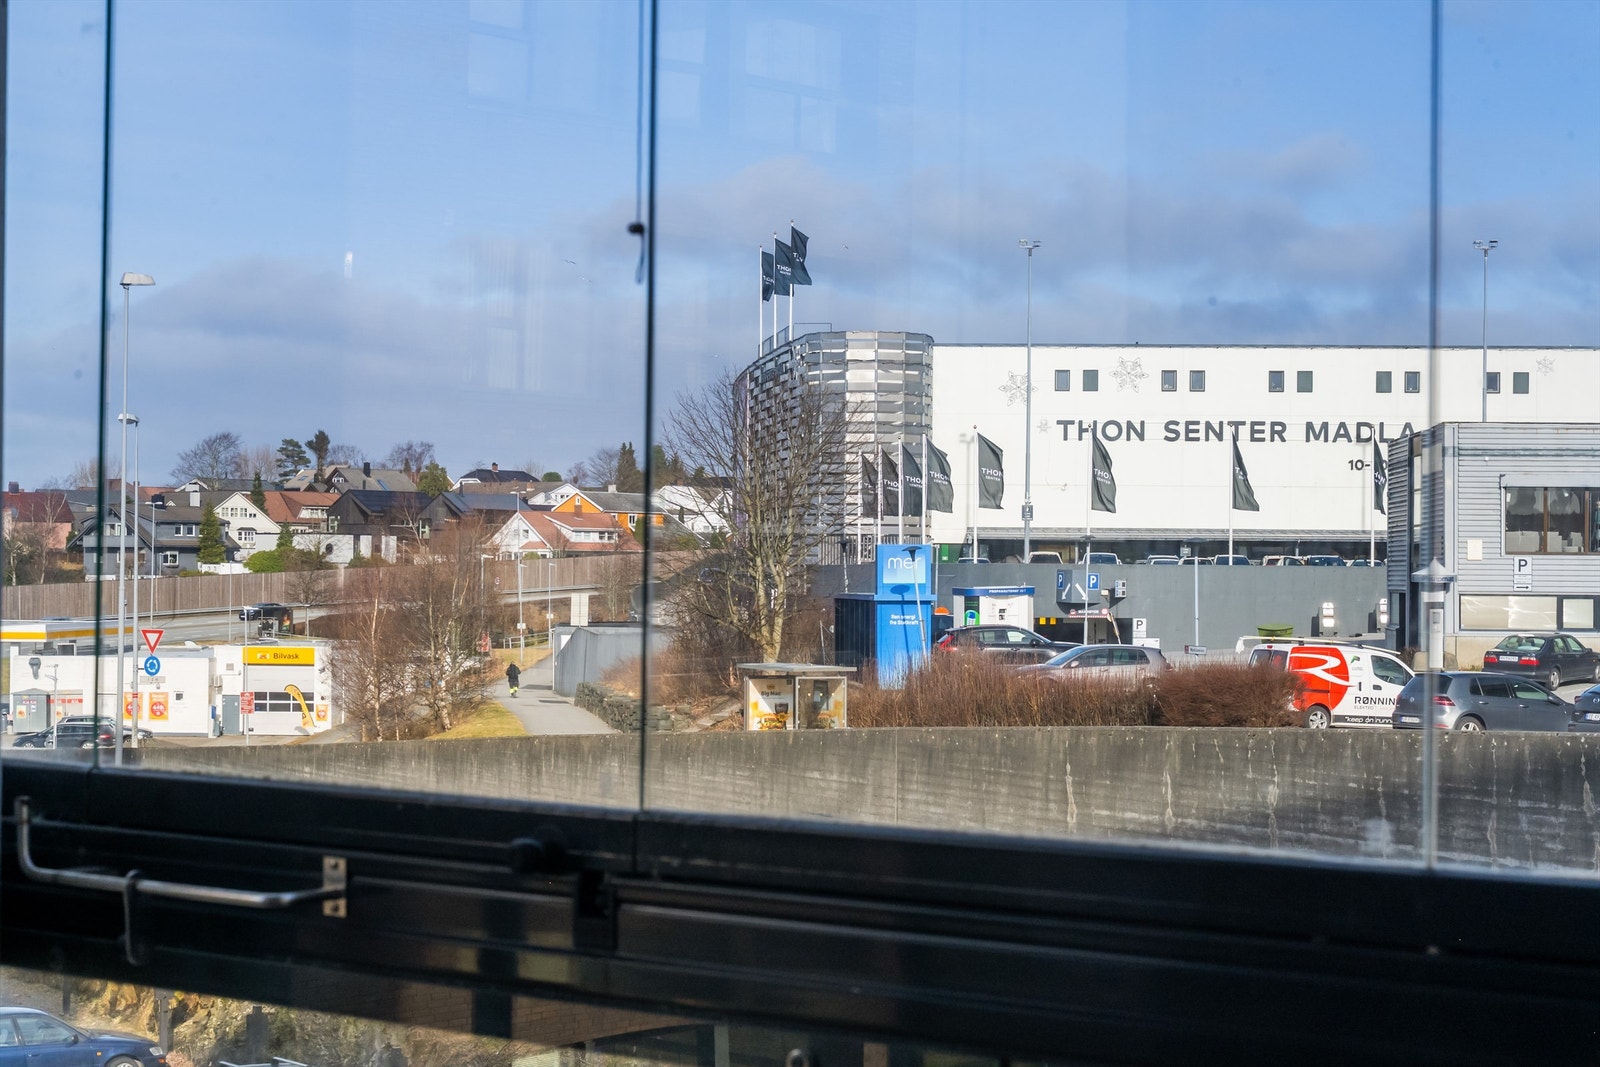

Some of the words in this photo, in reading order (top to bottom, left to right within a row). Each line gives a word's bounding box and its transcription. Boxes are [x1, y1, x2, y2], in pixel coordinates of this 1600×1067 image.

[1056, 420, 1145, 442] THON
[1164, 420, 1287, 442] SENTER
[1305, 421, 1415, 443] MADLA
[905, 475, 923, 484] THO
[1094, 468, 1111, 480] THO
[883, 479, 899, 487] THO
[888, 557, 922, 569] mer
[1518, 559, 1528, 572] P
[1058, 573, 1063, 583] P
[1090, 576, 1097, 588] P
[1136, 619, 1144, 630] P
[273, 652, 299, 660] Bilvask
[1354, 696, 1396, 706] RØNNIN
